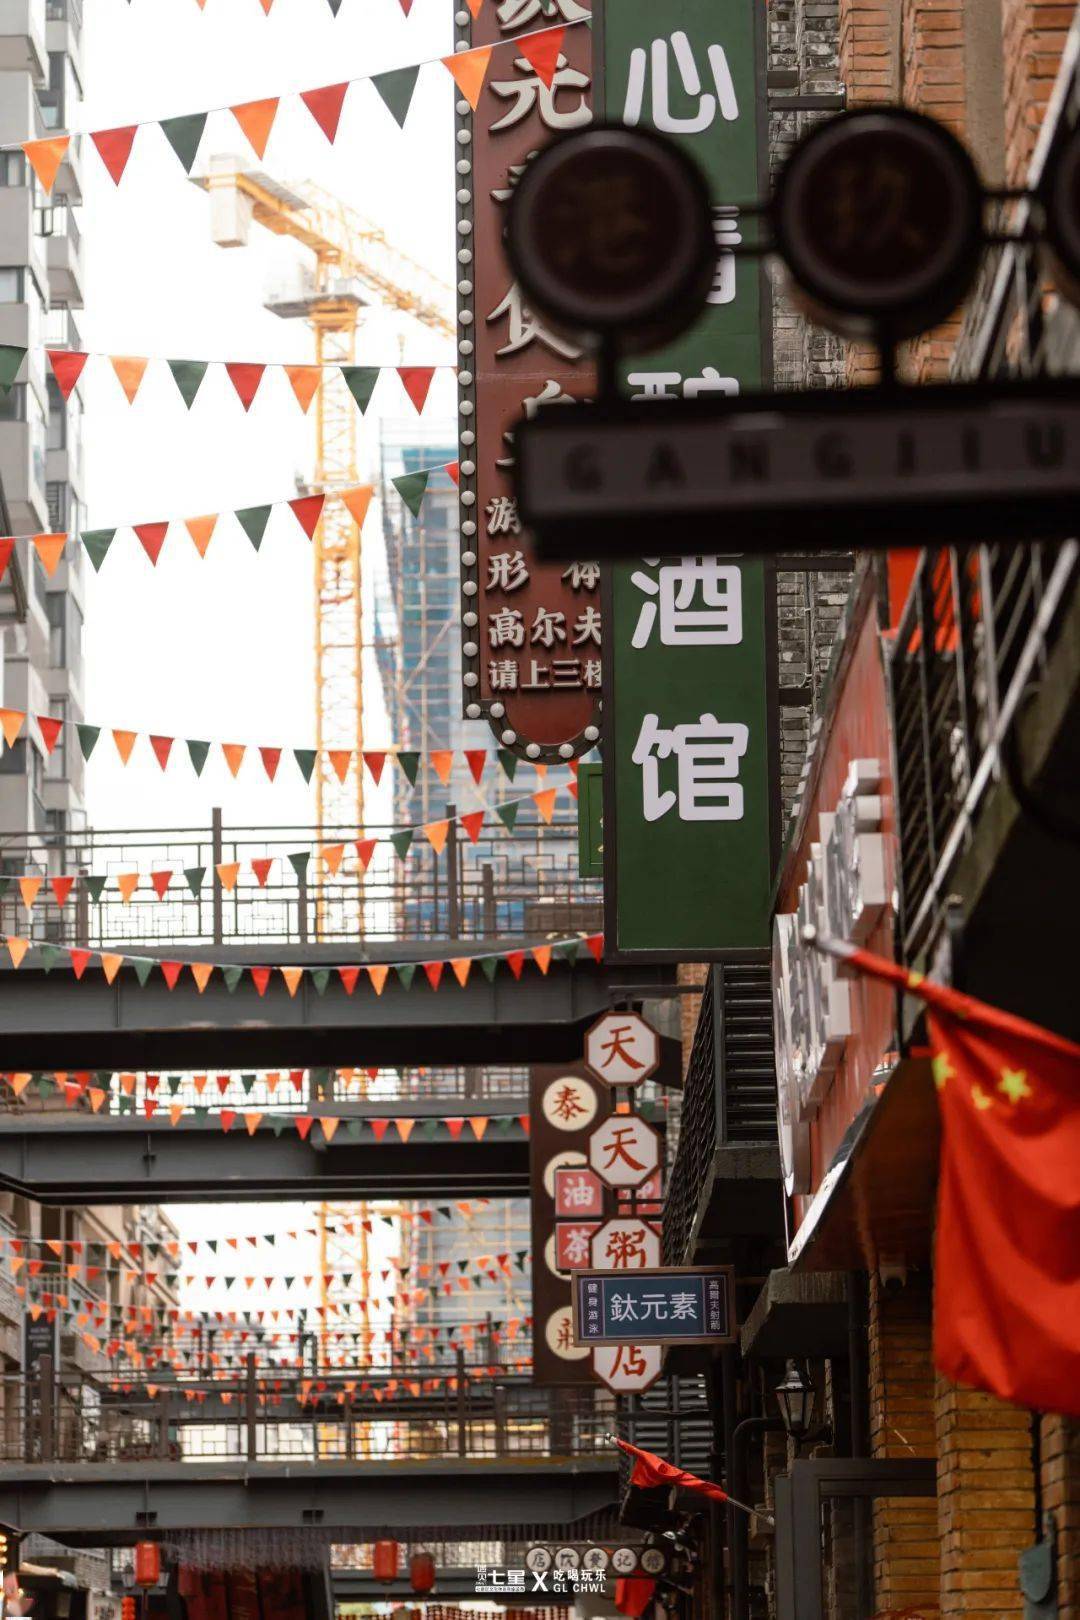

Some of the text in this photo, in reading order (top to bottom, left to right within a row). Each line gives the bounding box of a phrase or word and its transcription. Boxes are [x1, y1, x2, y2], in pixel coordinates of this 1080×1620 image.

[623, 31, 750, 822] 心酒馆
[487, 606, 602, 649] 高尔夫
[610, 1292, 699, 1322] 鈦元素
